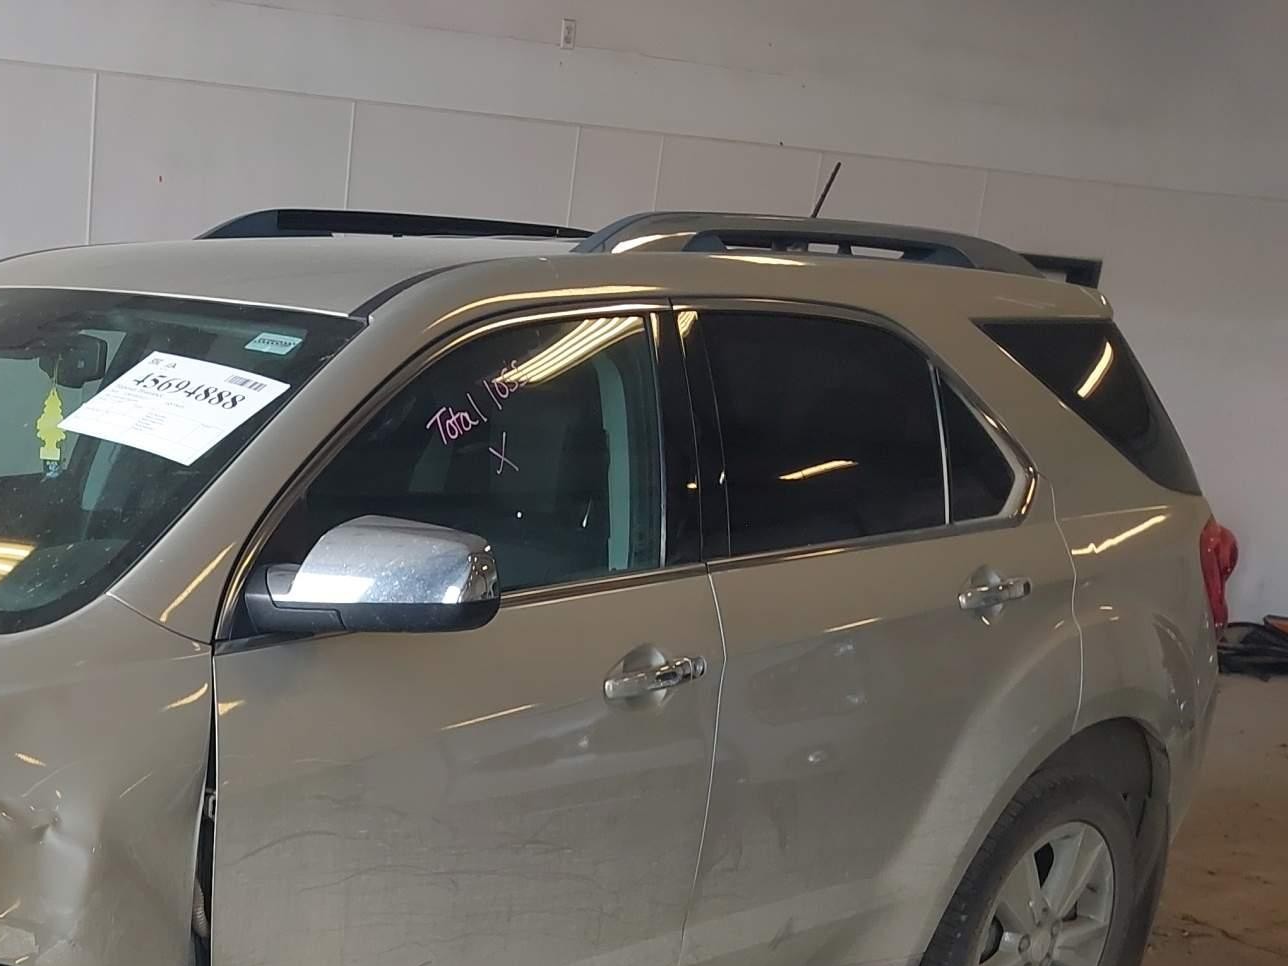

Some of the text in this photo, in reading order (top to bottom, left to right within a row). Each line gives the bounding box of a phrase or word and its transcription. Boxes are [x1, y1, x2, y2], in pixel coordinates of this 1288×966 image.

[131, 371, 247, 411] 45694888
[425, 359, 529, 445] Total loss
